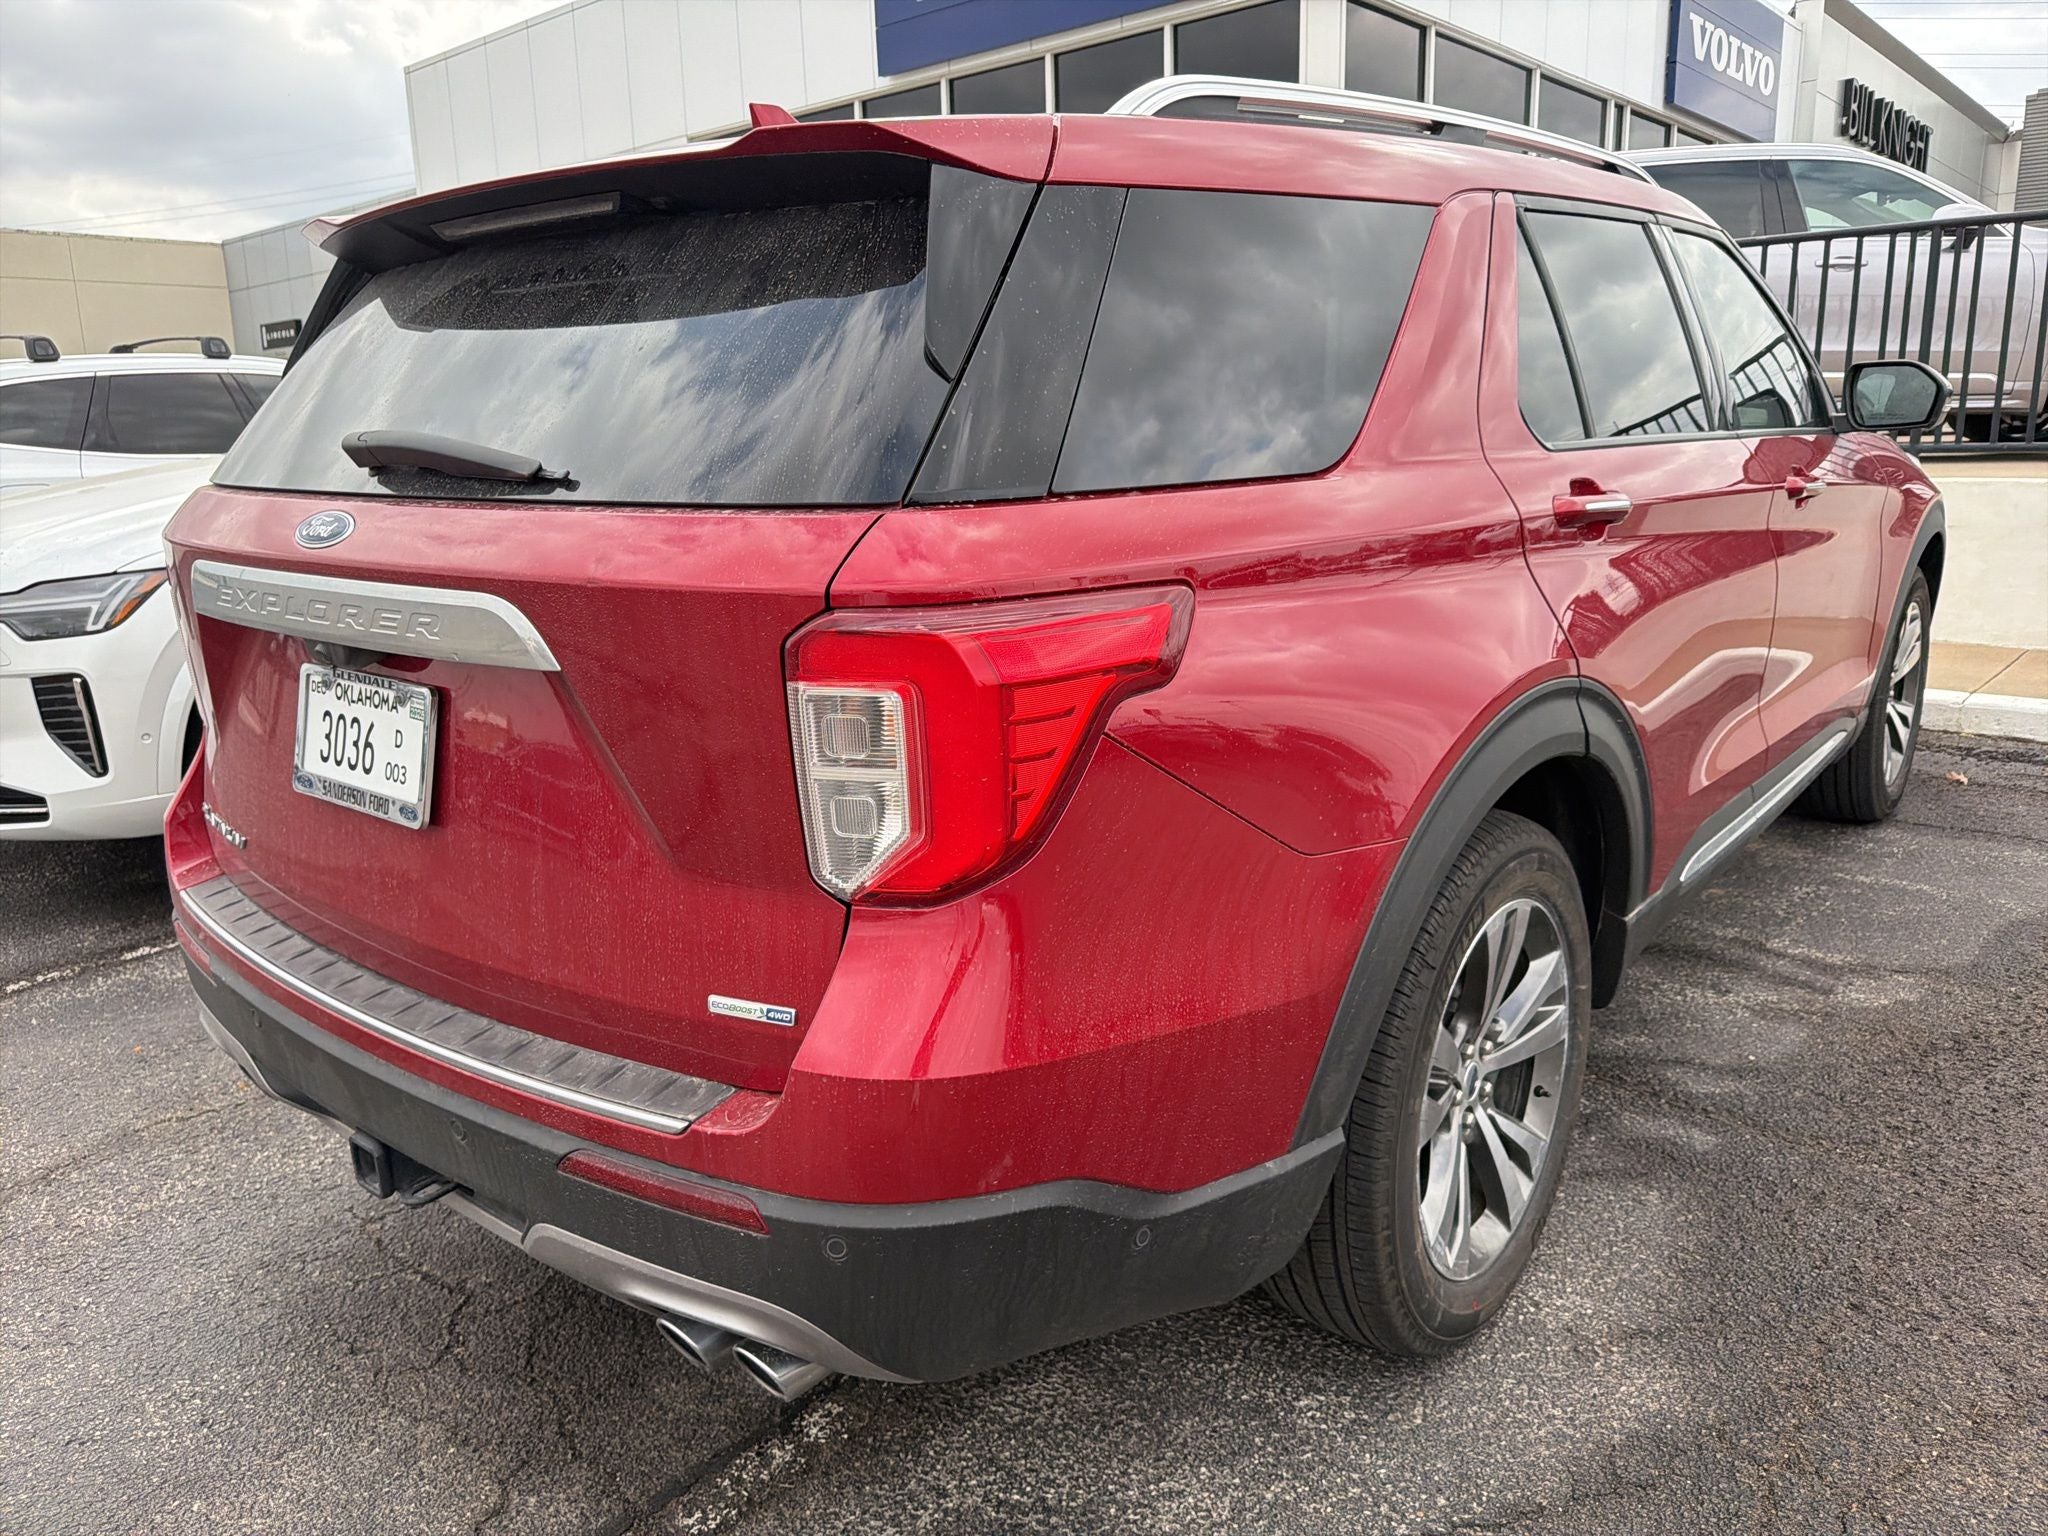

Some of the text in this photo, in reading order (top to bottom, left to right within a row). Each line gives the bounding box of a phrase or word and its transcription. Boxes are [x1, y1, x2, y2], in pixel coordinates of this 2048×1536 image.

[1689, 12, 1775, 97] VOLVO
[1843, 78, 1876, 147] BILL
[266, 328, 295, 341] LINCOLN
[216, 584, 441, 641] EXPLORER
[333, 669, 397, 691] GLENDALE
[335, 682, 399, 714] OKLAHOMA
[320, 710, 375, 775] 3036
[395, 730, 403, 748] D
[385, 762, 407, 785] 003
[322, 780, 367, 809] SANDERSON
[368, 794, 390, 815] FORD
[711, 1001, 791, 1021] ECOBOOST 4WD
